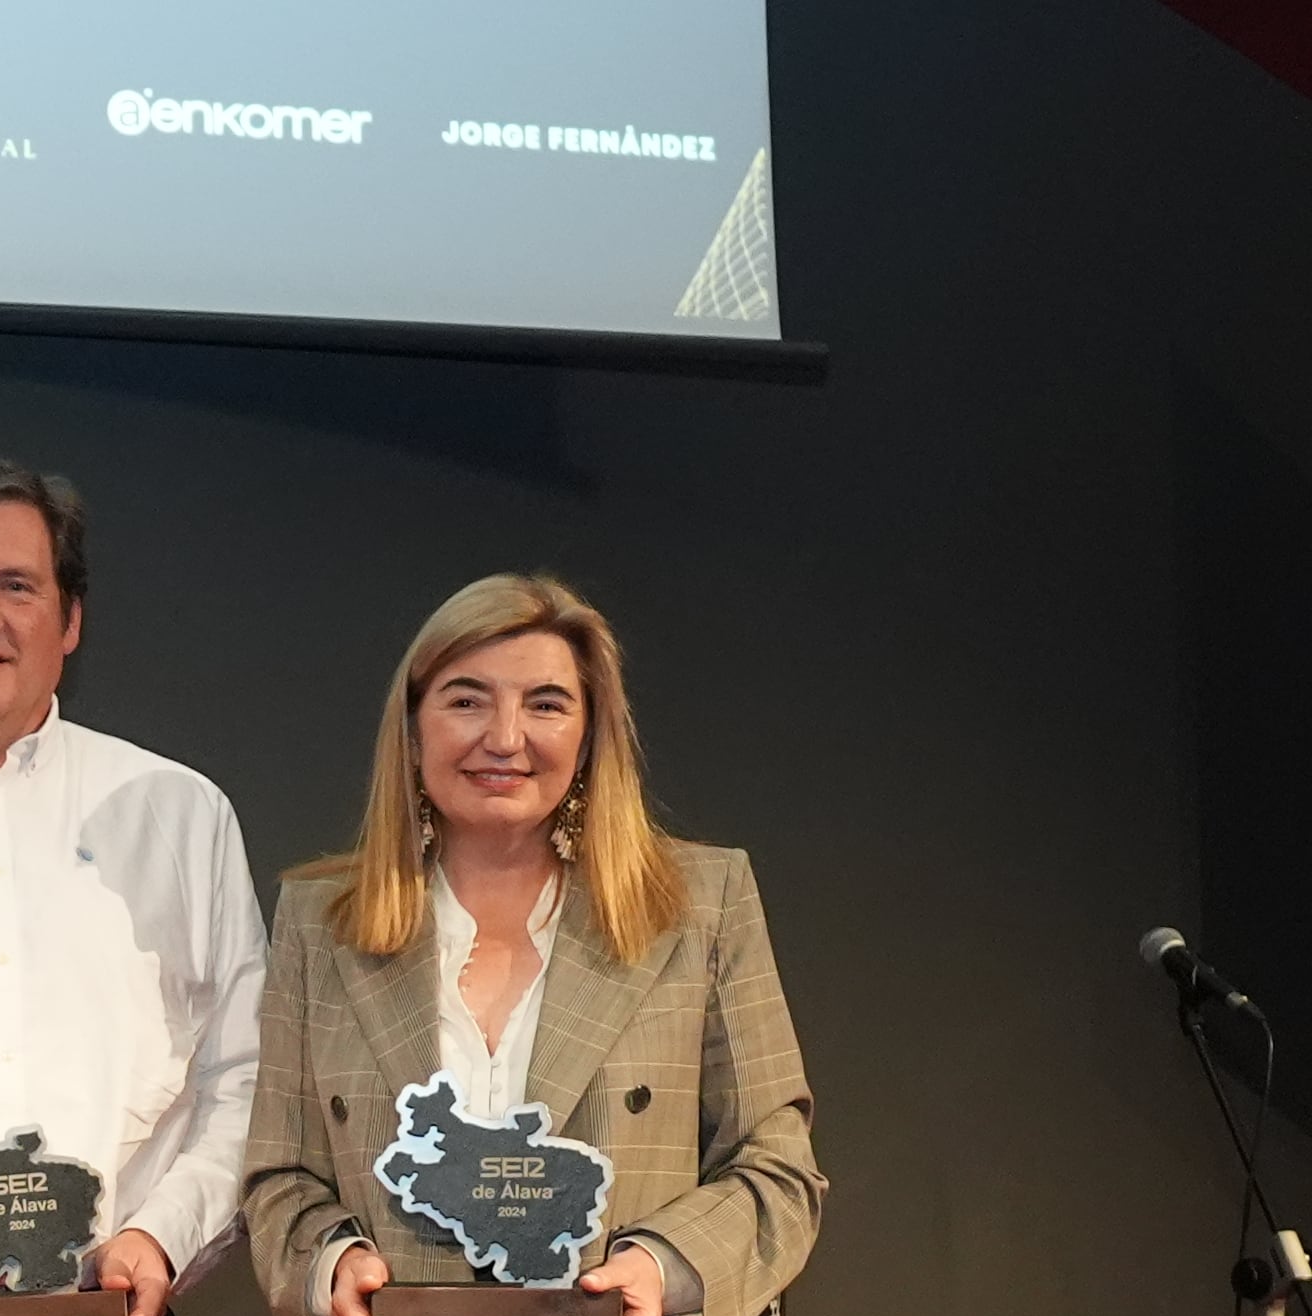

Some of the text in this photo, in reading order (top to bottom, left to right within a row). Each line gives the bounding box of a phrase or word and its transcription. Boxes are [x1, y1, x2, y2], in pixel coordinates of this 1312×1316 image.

[441, 120, 717, 161] JORGE FERNÁNDEZ
[480, 1156, 545, 1179] SER
[472, 1180, 554, 1200] de Álava
[10, 1195, 58, 1215] Álava
[497, 1206, 526, 1217] 2024
[9, 1219, 36, 1231] 2024
